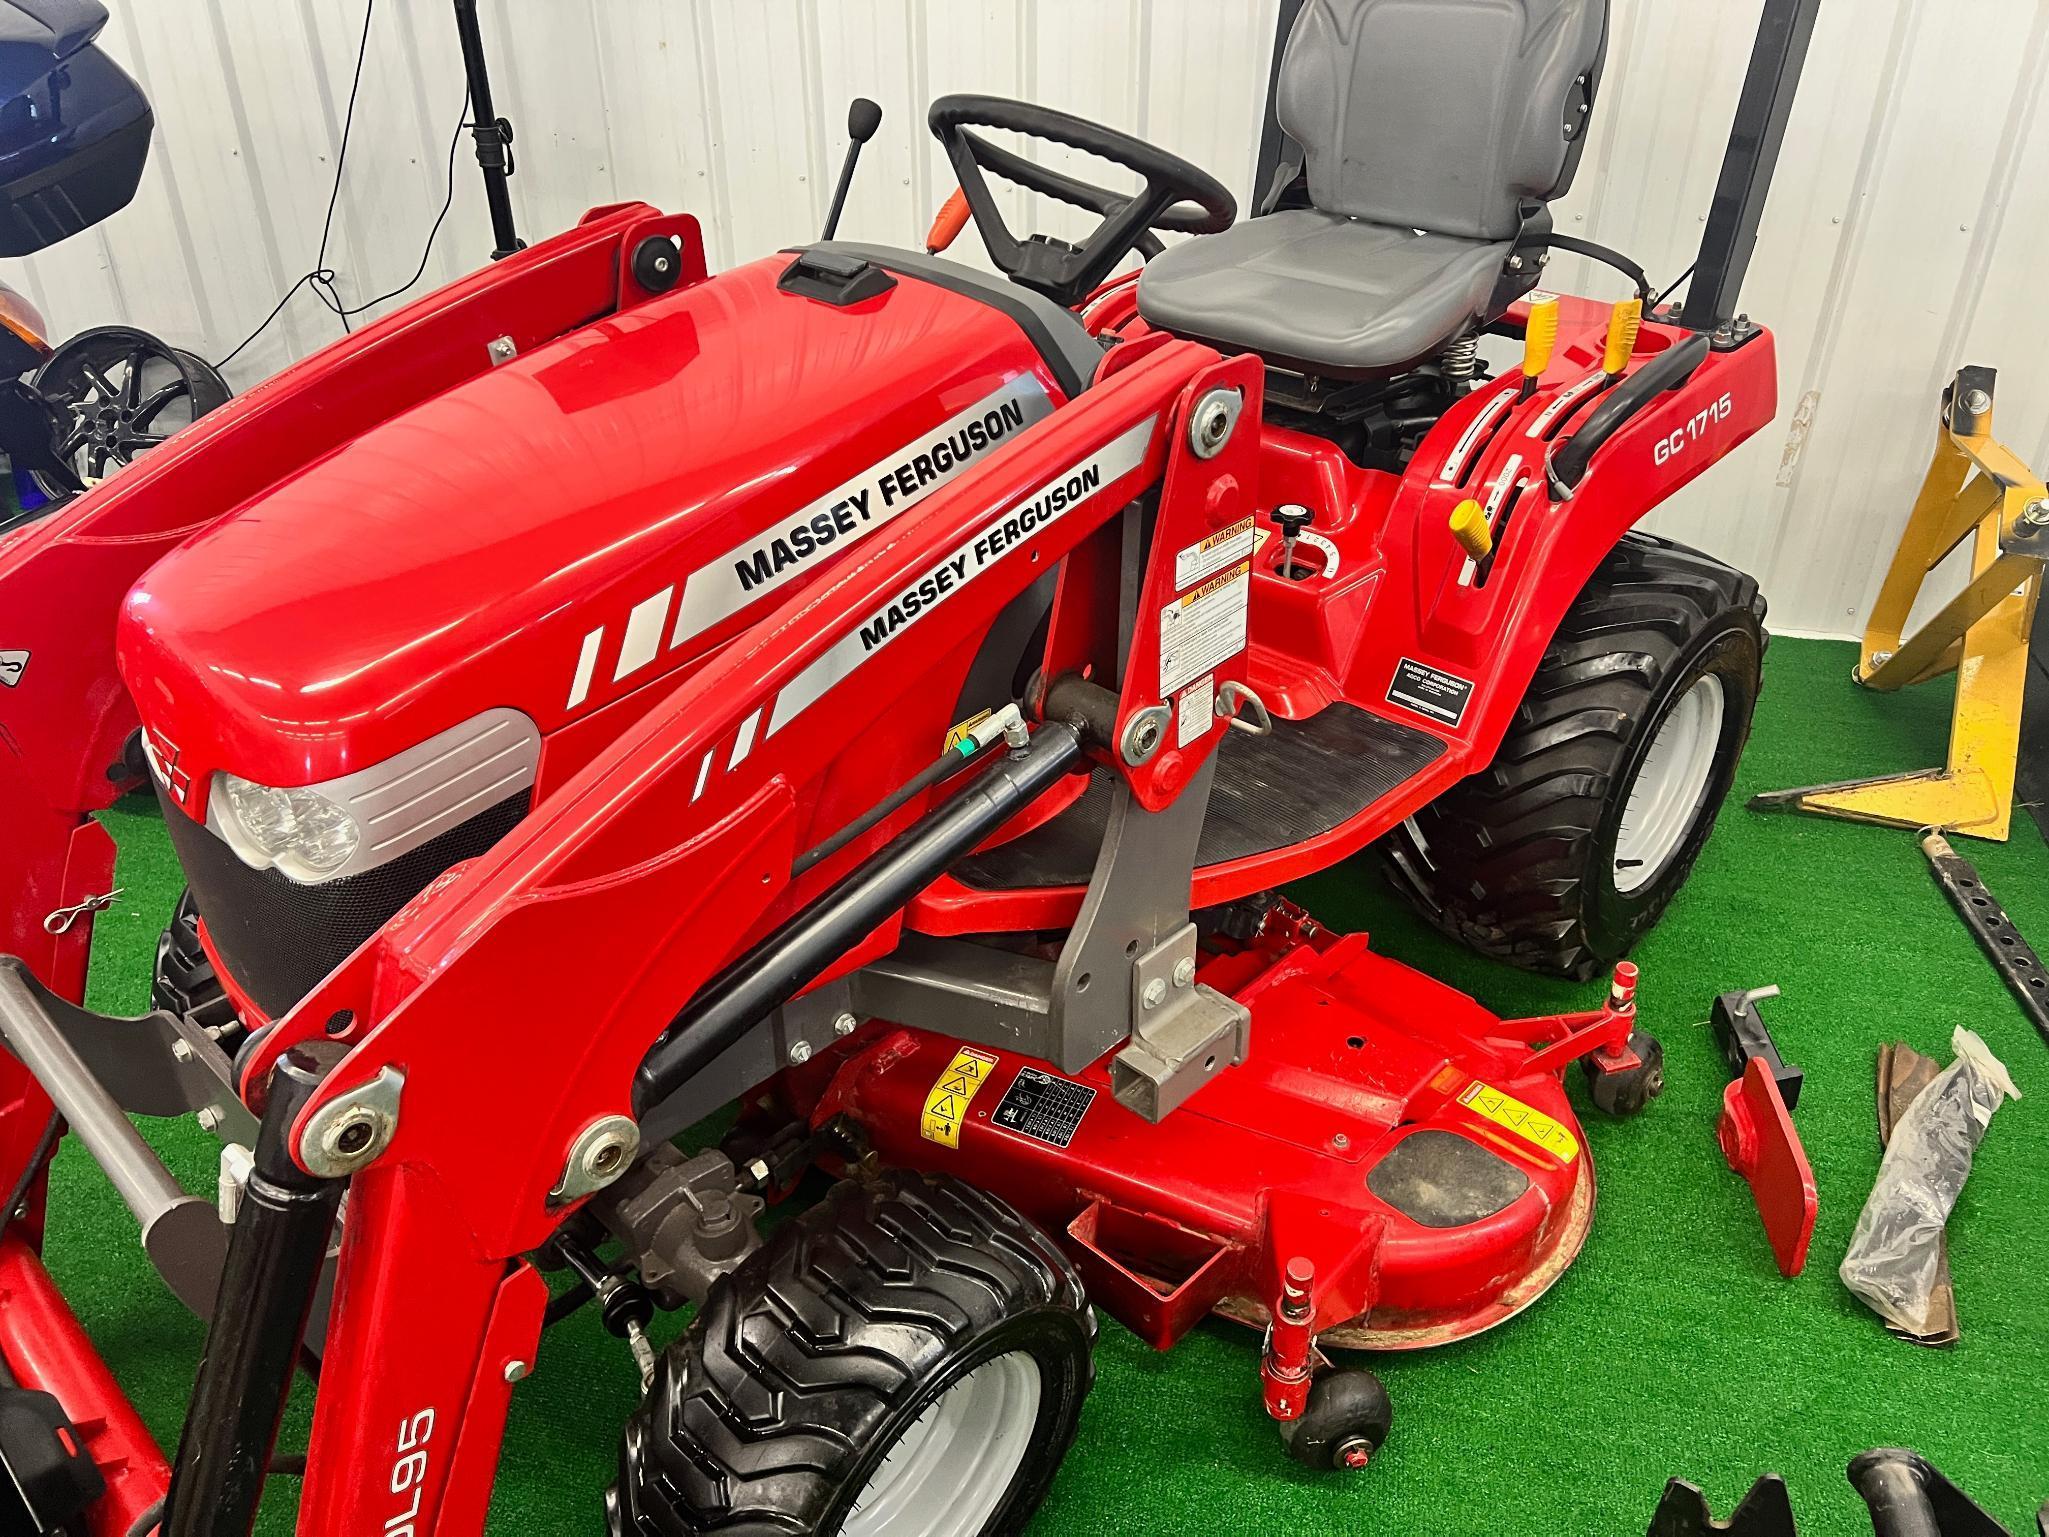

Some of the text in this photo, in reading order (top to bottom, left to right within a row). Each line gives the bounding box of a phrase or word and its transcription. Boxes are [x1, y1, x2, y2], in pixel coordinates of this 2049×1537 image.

[1654, 391, 1732, 466] GC 1715
[734, 398, 1024, 592] MASSEY FERGUSON
[1212, 518, 1252, 545] WARNING
[859, 464, 1100, 652] MASSEY FERGUSON
[1201, 566, 1241, 596] WARNING
[1403, 663, 1430, 677] MASSEY
